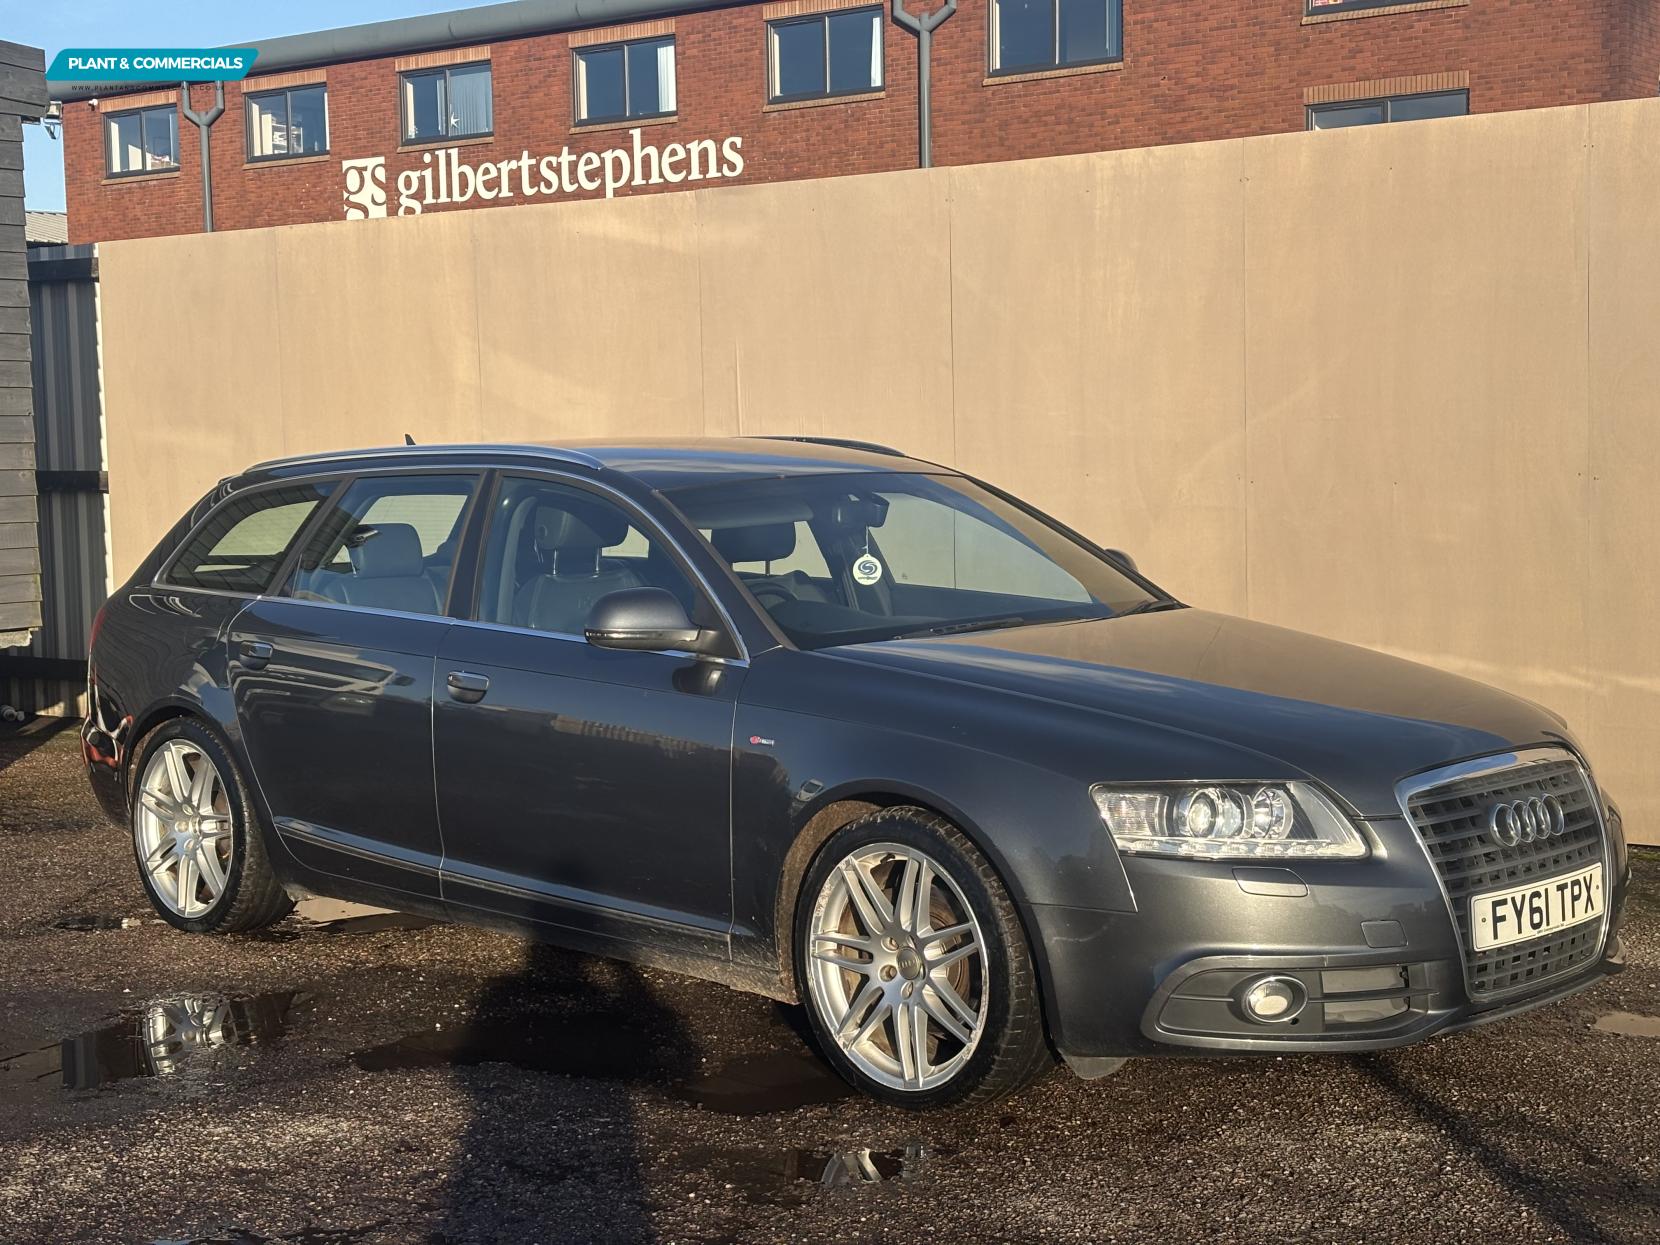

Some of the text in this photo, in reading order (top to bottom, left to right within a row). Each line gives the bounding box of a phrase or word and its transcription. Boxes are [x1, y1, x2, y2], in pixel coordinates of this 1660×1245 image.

[397, 129, 744, 217] gilbertstephens
[1491, 873, 1595, 940] FY61 TPX
